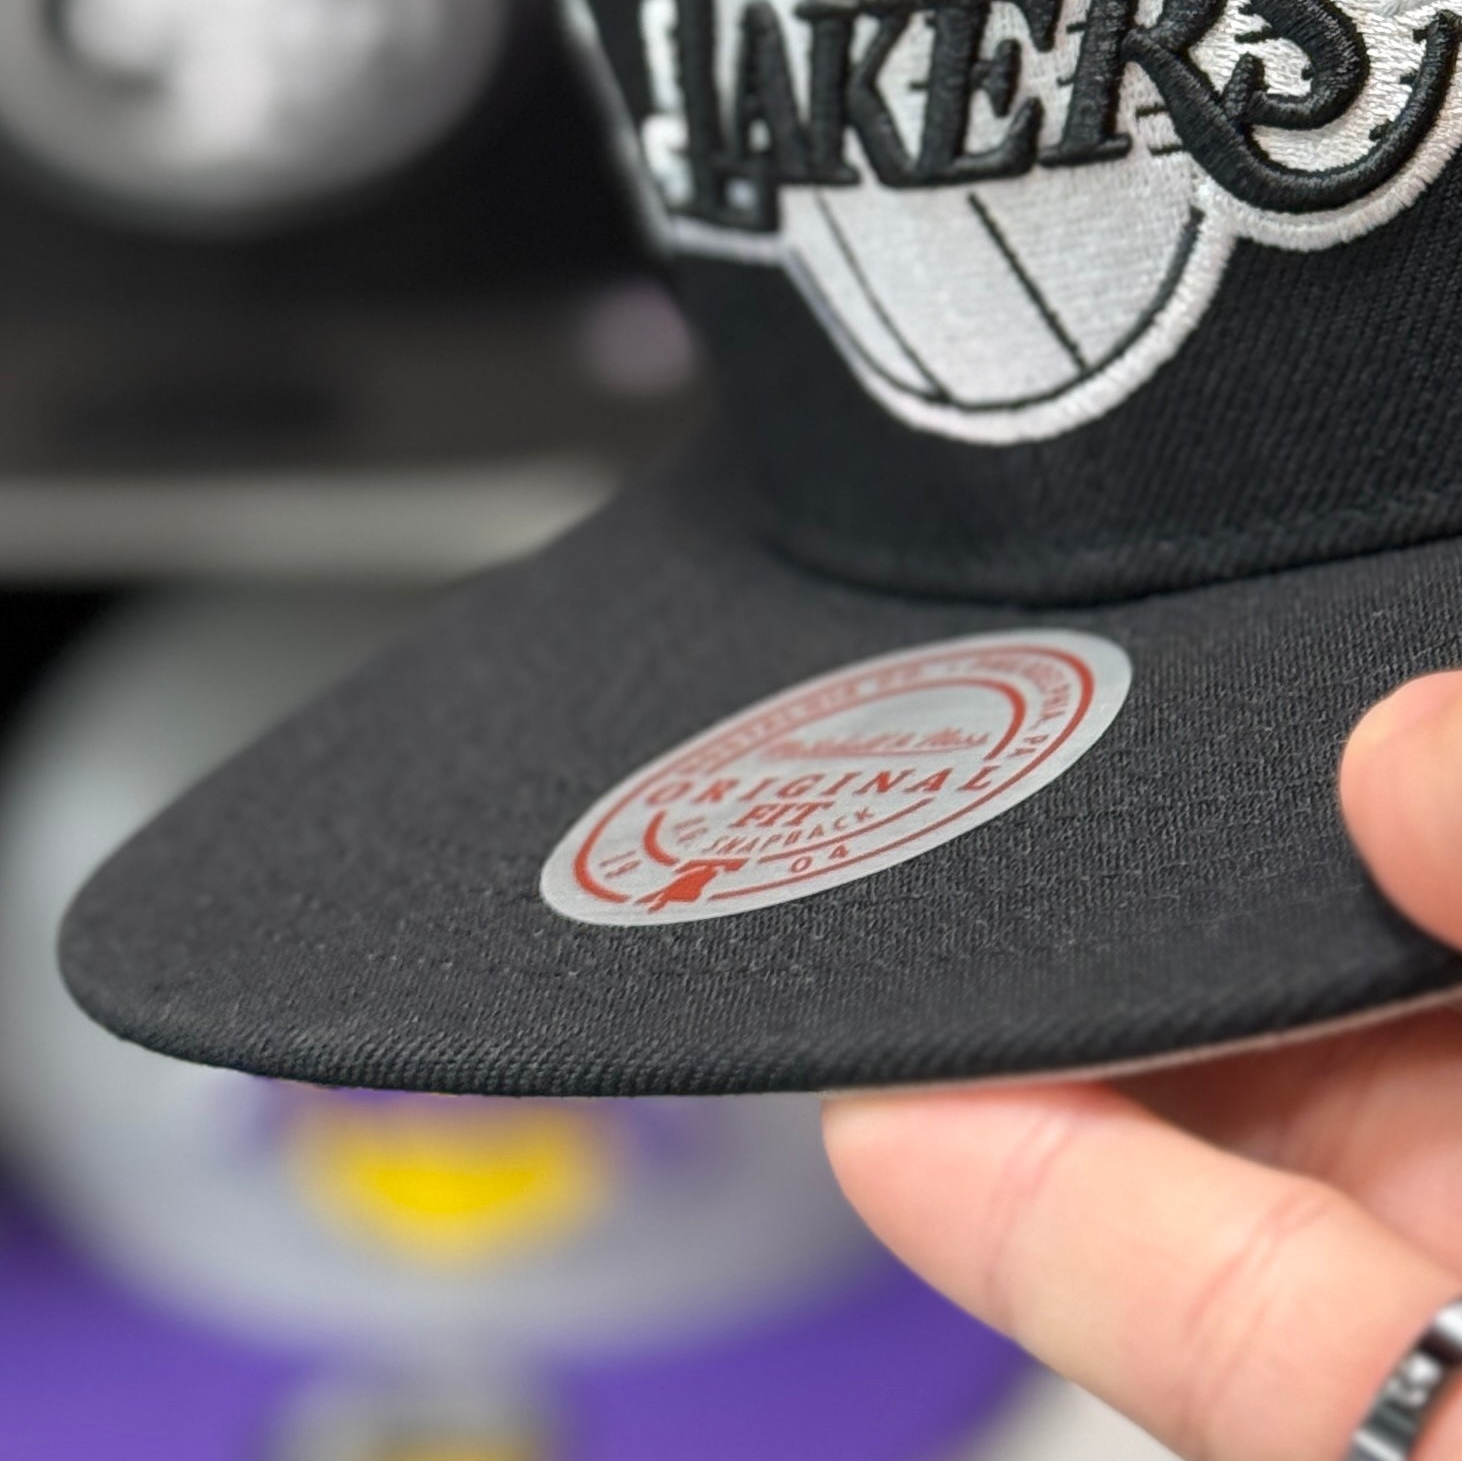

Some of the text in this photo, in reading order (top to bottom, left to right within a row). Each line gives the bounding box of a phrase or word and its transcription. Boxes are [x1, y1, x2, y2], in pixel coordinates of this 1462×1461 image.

[645, 764, 1001, 806] ORIGINAL
[703, 805, 875, 857] SNAPBACK
[728, 800, 836, 829] FIT
